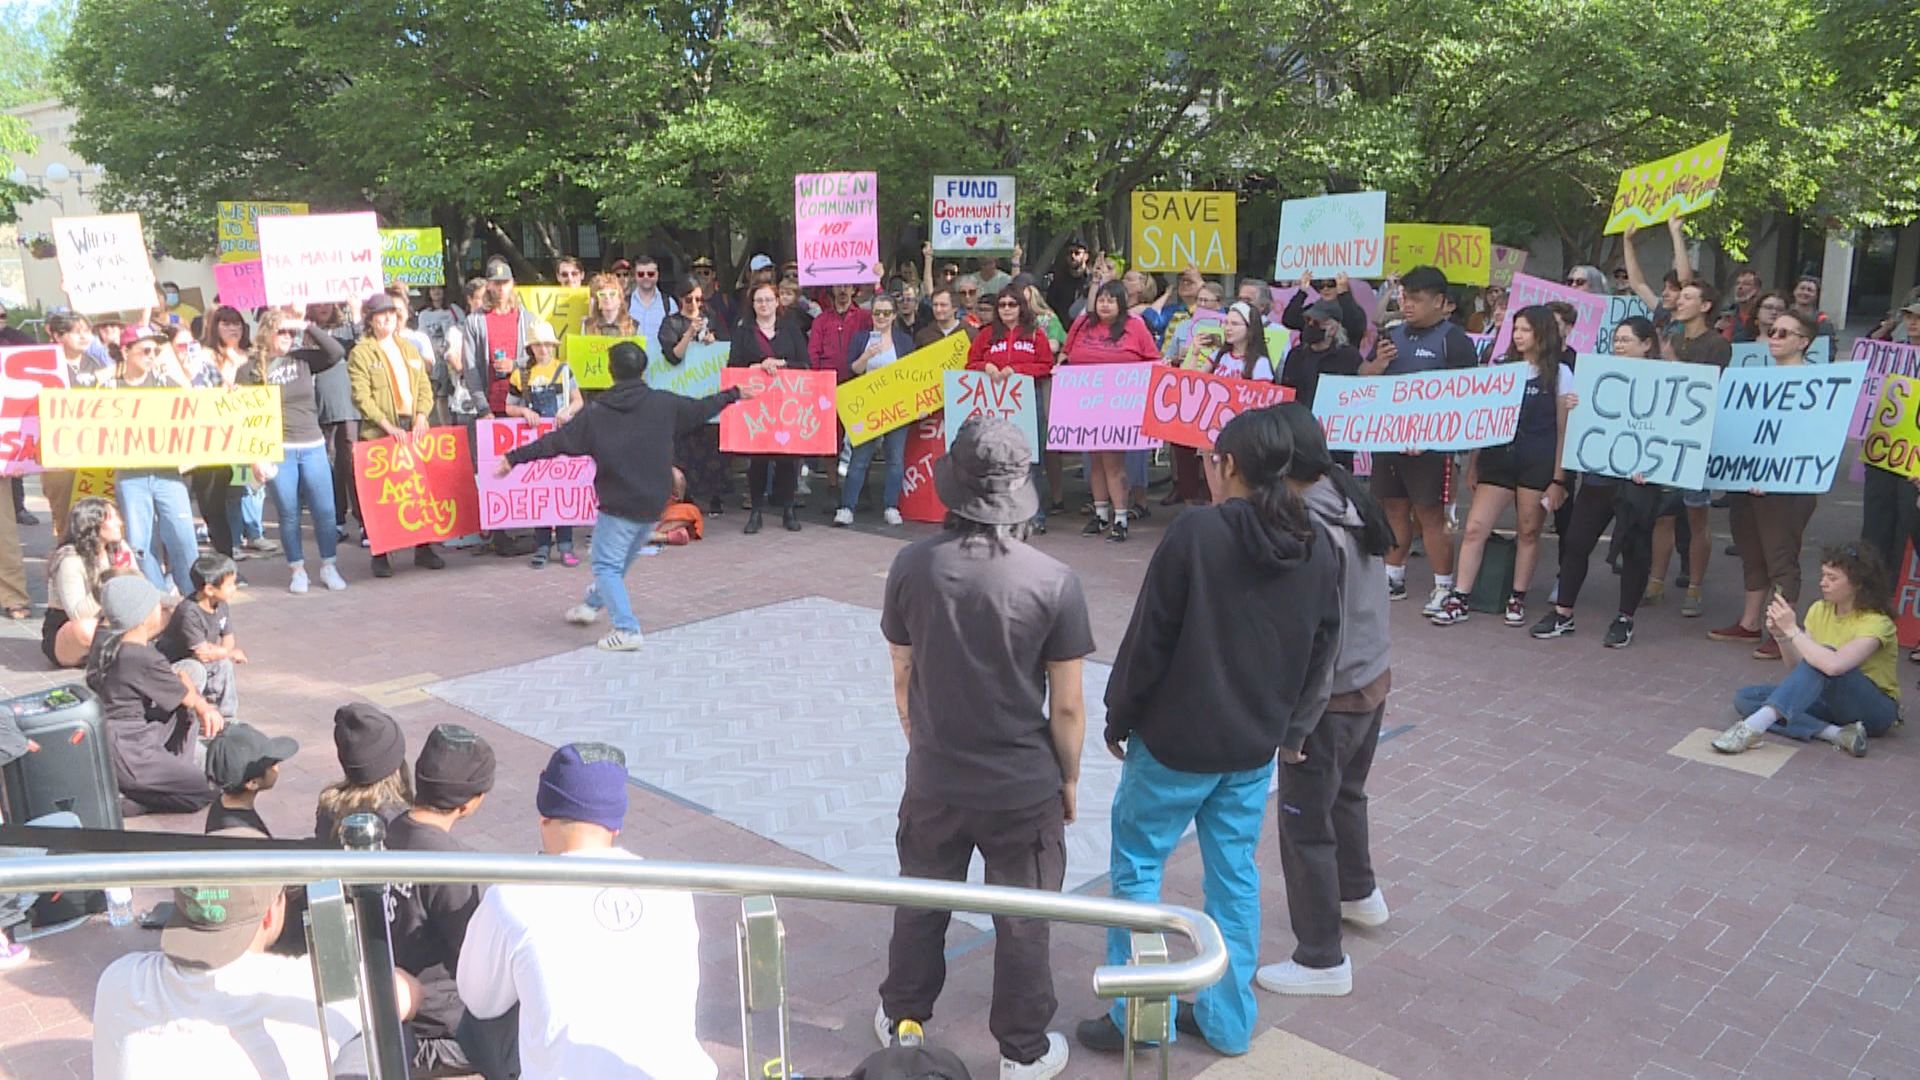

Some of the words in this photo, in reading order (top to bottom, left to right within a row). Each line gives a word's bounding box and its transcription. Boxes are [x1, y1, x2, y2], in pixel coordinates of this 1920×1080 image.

[799, 175, 868, 198] WIDEN
[947, 181, 998, 198] FUND
[801, 199, 874, 218] COMMUNITY
[1142, 193, 1221, 223] SAVE
[818, 221, 852, 235] NOT
[941, 219, 1001, 235] Grants
[351, 248, 372, 262] WI
[409, 251, 444, 268] COST
[804, 240, 874, 260] KENASTON
[1138, 226, 1231, 270] S.N.A.
[1280, 236, 1379, 270] COMMUNITY
[1432, 231, 1484, 268] ARTS
[748, 374, 812, 397] SAVE
[848, 396, 865, 415] DO
[866, 374, 889, 396] THE
[894, 368, 934, 383] RIGHT
[957, 374, 1022, 410] SAVE
[1058, 371, 1104, 388] TAKE
[1338, 384, 1380, 407] SAVE
[1392, 372, 1516, 403] BROADWAY
[1723, 377, 1852, 411] INVEST
[50, 398, 142, 419] INVEST
[171, 396, 198, 420] IN
[866, 400, 909, 432] SAVE
[914, 383, 943, 412] ART
[1079, 394, 1104, 409] OF
[1592, 371, 1713, 426] CUTS
[242, 415, 273, 428] NOT
[743, 402, 776, 441] Art
[780, 398, 820, 440] City
[1318, 410, 1462, 444] NEIGHBOURHOOD
[1464, 403, 1520, 441] CENTRE
[1627, 419, 1656, 431] WILL
[1753, 419, 1782, 445] IN
[53, 425, 234, 456] COMMUNITY
[238, 432, 275, 456] LESS
[1577, 427, 1701, 483] COST
[521, 458, 590, 484] NOT
[902, 453, 933, 498] ART
[377, 470, 425, 504] Art
[398, 491, 457, 535] City
